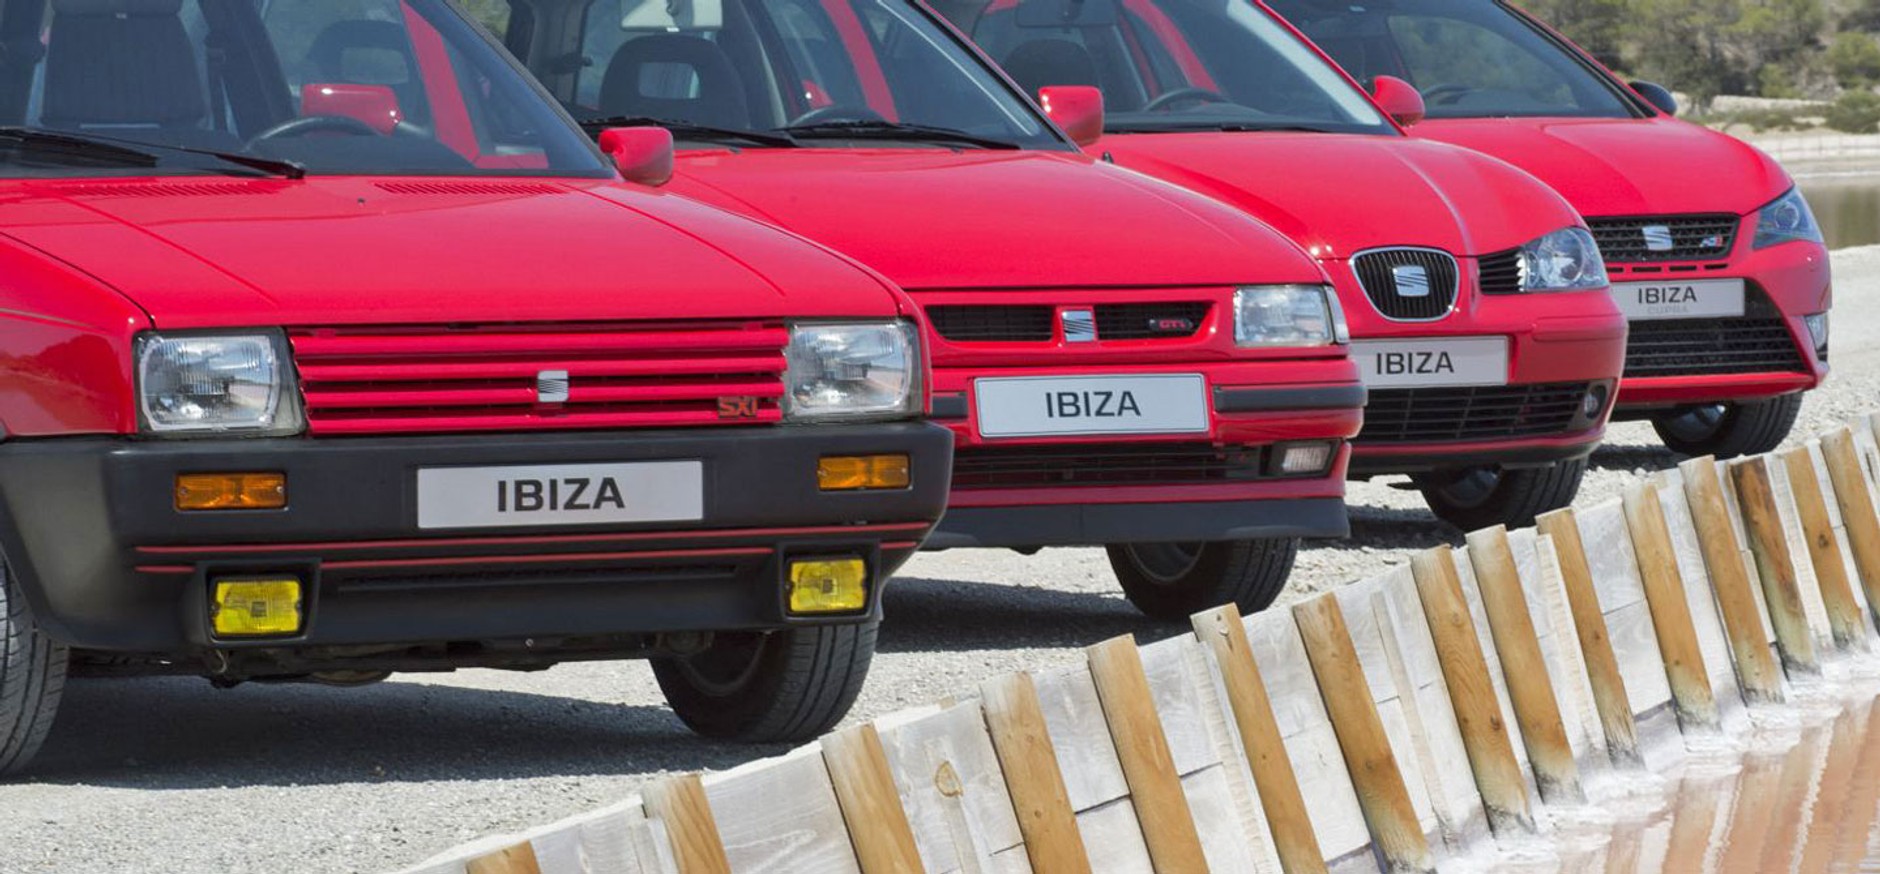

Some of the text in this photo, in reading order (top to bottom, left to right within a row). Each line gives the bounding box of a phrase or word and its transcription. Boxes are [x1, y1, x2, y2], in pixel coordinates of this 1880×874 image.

[1638, 286, 1698, 304] IBIZA
[1376, 351, 1454, 375] IBIZA
[1045, 390, 1141, 418] IBIZA
[498, 477, 625, 512] IBIZA
